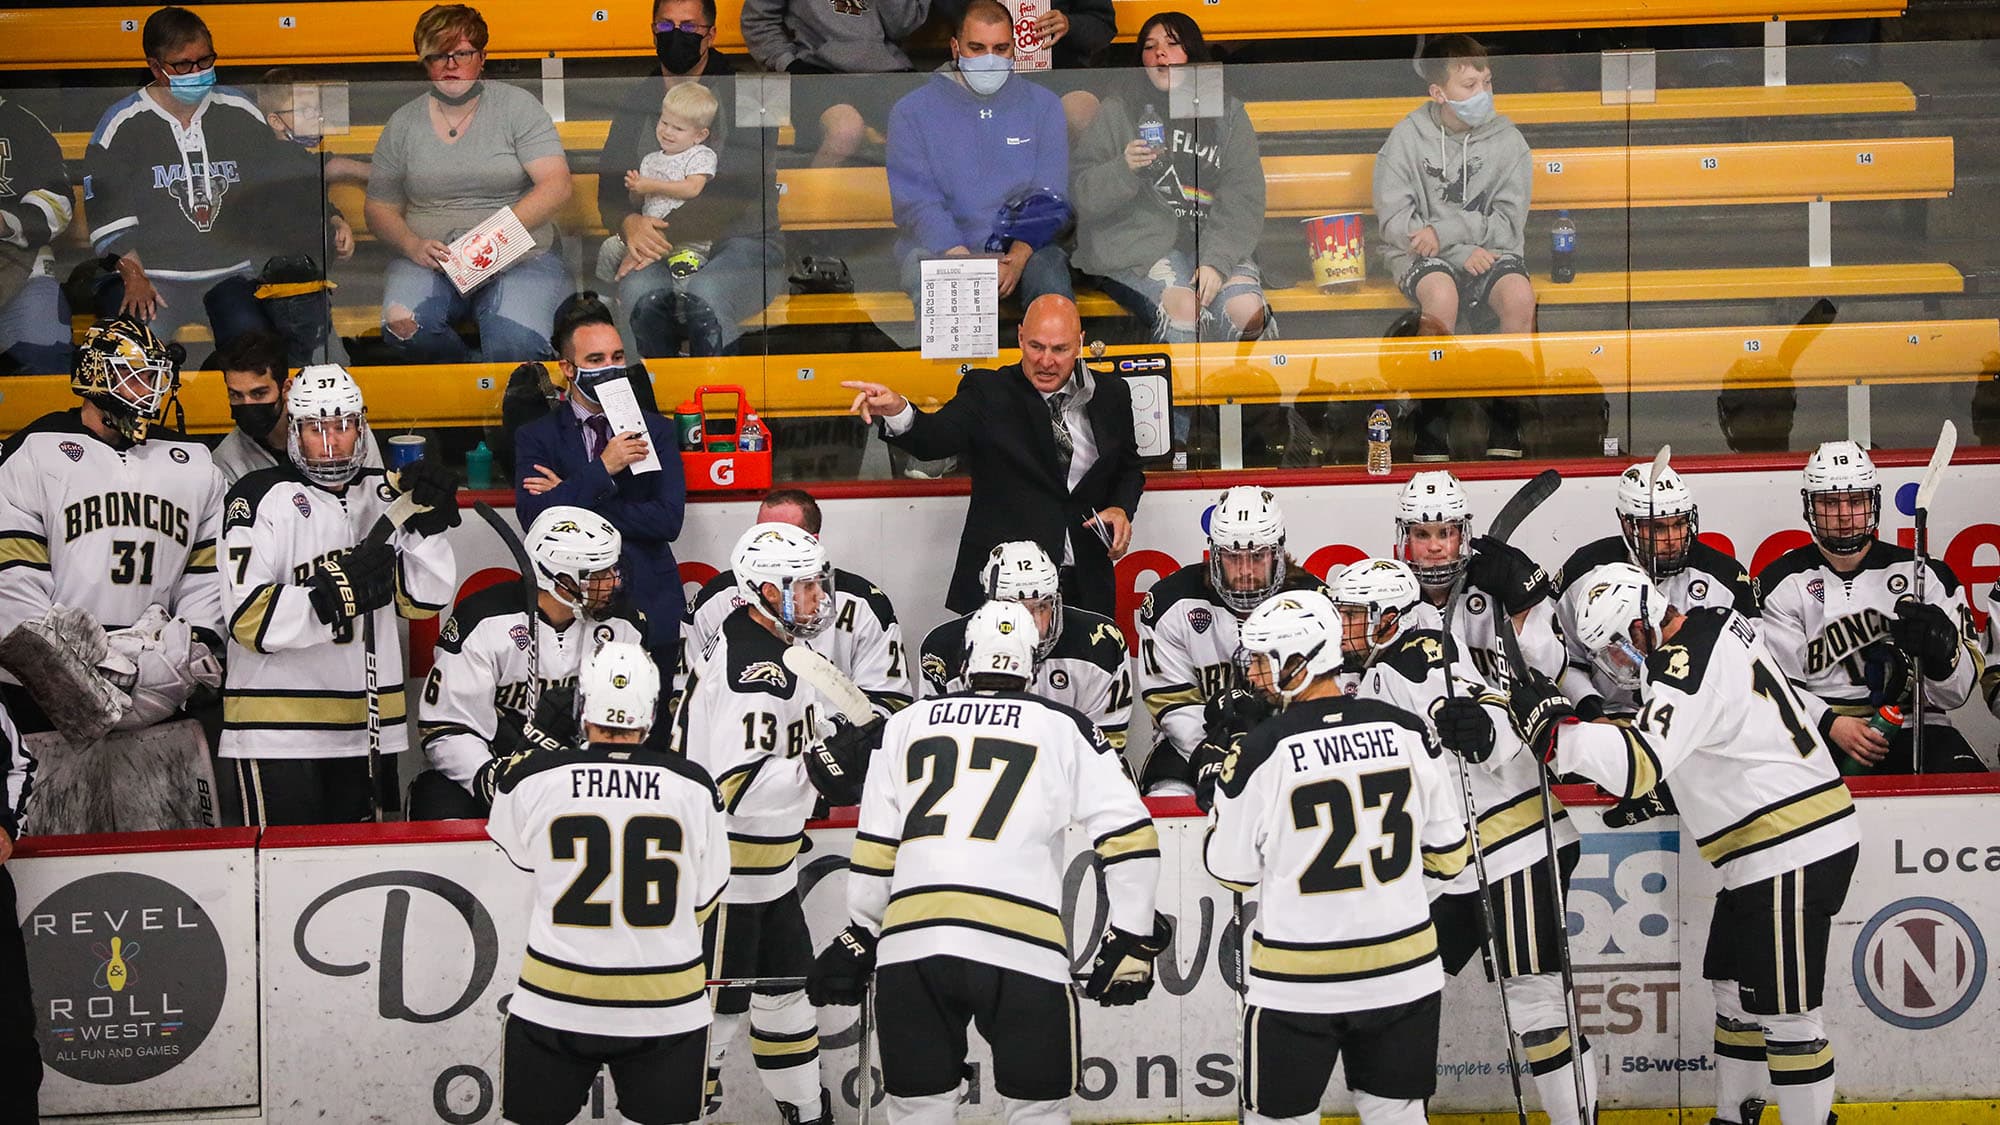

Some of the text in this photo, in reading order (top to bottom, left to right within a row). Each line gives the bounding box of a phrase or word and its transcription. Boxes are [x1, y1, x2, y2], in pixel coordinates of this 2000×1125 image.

[283, 18, 291, 27] 4
[596, 11, 604, 20] 6
[126, 21, 133, 30] 3
[1704, 159, 1716, 168] 13
[1859, 154, 1871, 163] 14
[1548, 163, 1560, 172] 12
[1746, 341, 1759, 351] 13
[1275, 355, 1286, 365] 10
[1432, 351, 1442, 360] 11
[802, 369, 809, 379] 7
[961, 364, 968, 374] 8
[318, 378, 335, 388] 37
[481, 379, 489, 389] 5
[1833, 455, 1848, 466] 18
[1427, 485, 1435, 495] 9
[1656, 480, 1673, 491] 34
[64, 491, 189, 547] BRONCOS
[1238, 510, 1248, 520] 11
[111, 540, 156, 585] 31
[228, 546, 252, 585] 7
[1017, 560, 1033, 571] 12
[836, 599, 856, 633] A
[1188, 612, 1212, 622] NCHC
[992, 655, 1011, 670] 27
[1142, 639, 1163, 675] 11
[1104, 669, 1133, 715] 12
[606, 709, 626, 723] 26
[929, 702, 1022, 729] GLOVER
[1639, 697, 1674, 739] 14
[742, 711, 778, 752] 13
[1288, 728, 1399, 772] P. WASHE
[571, 769, 661, 800] FRANK
[900, 735, 1039, 844] 27
[1290, 763, 1413, 897] 23
[549, 812, 684, 929] 26
[34, 907, 198, 936] REVEL
[110, 965, 124, 977] &
[50, 993, 183, 1020] ROLL
[80, 1022, 156, 1041] WEST
[56, 1045, 180, 1062] ALL FUN AND GAMES
[1622, 1053, 1716, 1074] 58-west.
